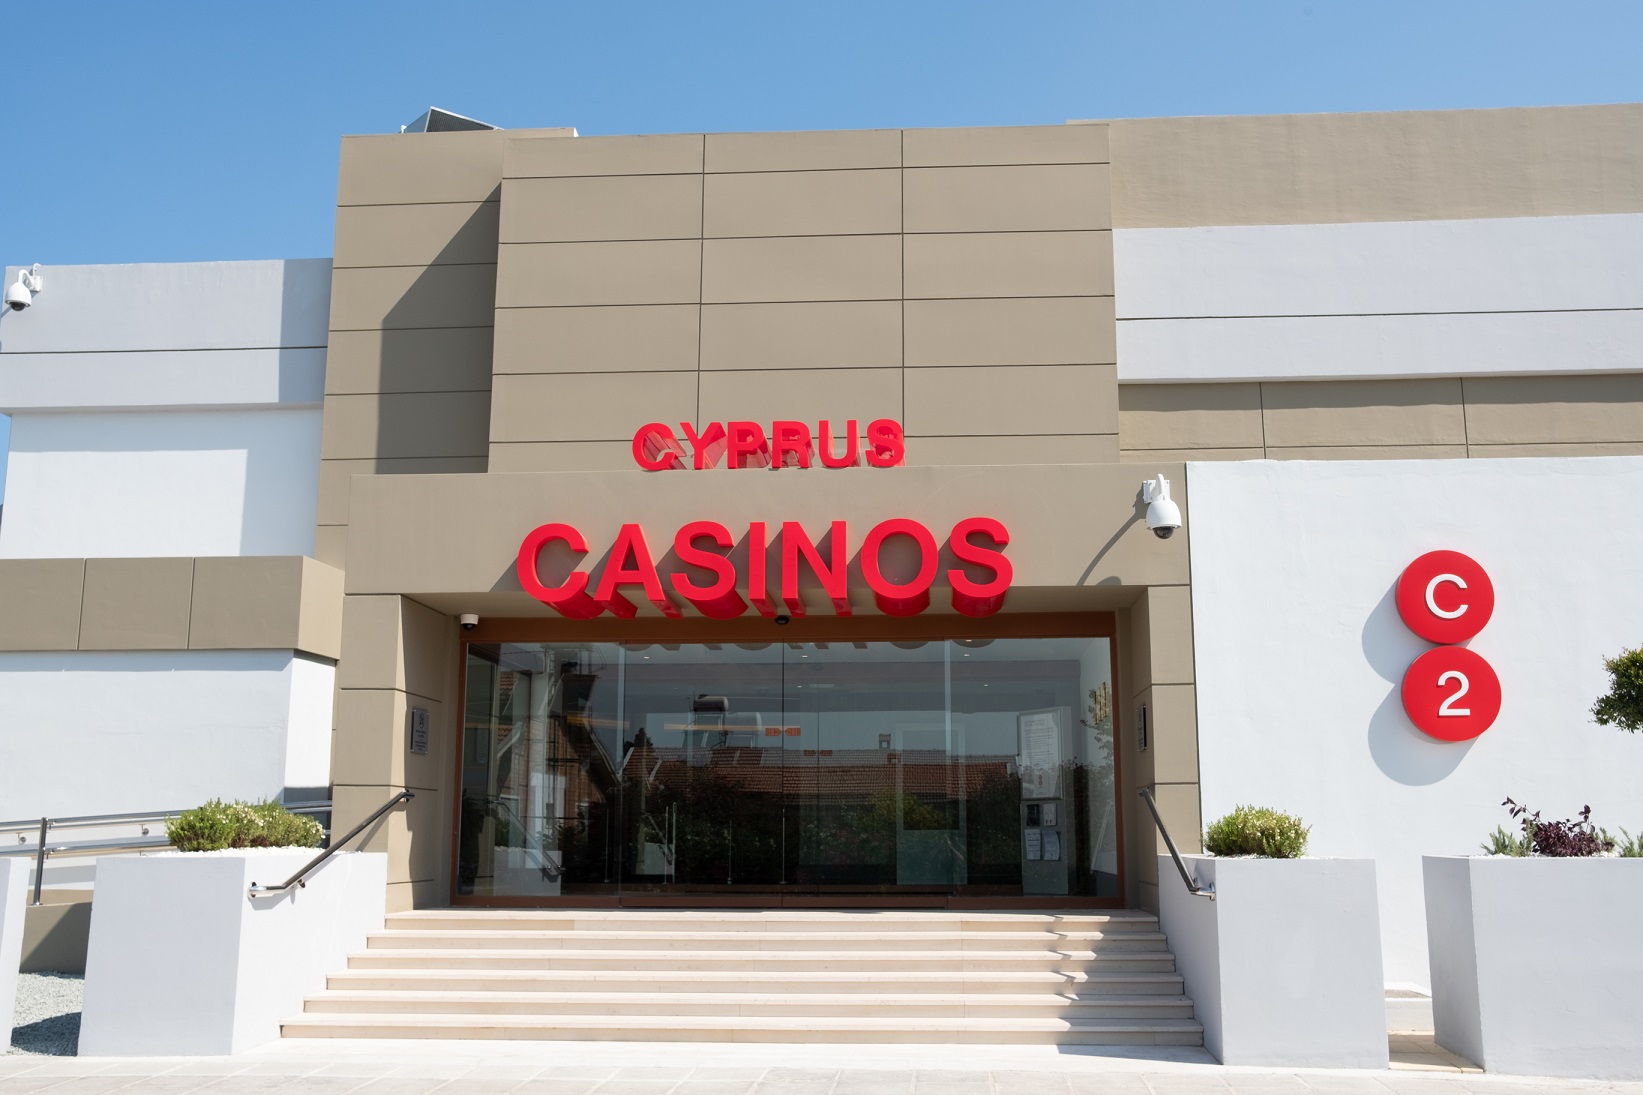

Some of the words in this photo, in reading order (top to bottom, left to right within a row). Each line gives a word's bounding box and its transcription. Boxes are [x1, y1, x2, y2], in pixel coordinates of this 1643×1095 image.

[632, 419, 906, 470] CYPRUS
[517, 517, 1013, 604] CASINOS
[1425, 573, 1469, 619] C
[1437, 670, 1471, 717] 2
